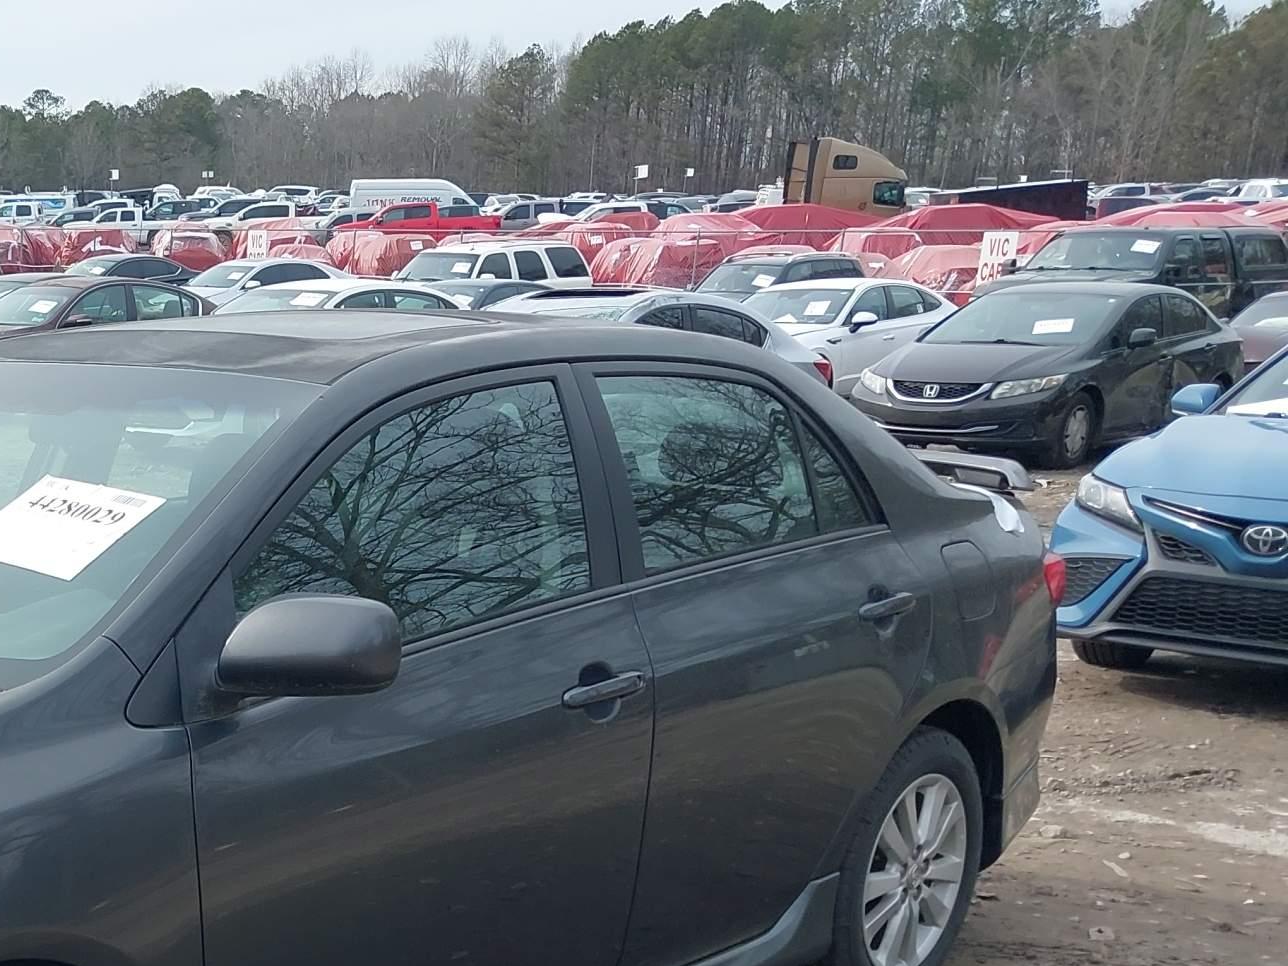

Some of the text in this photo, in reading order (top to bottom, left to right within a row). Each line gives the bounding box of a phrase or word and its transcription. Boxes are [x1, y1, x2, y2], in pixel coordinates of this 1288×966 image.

[251, 234, 263, 249] VIC
[989, 237, 1010, 257] VIC
[980, 262, 1003, 281] CAR
[28, 495, 126, 526] 44280029
